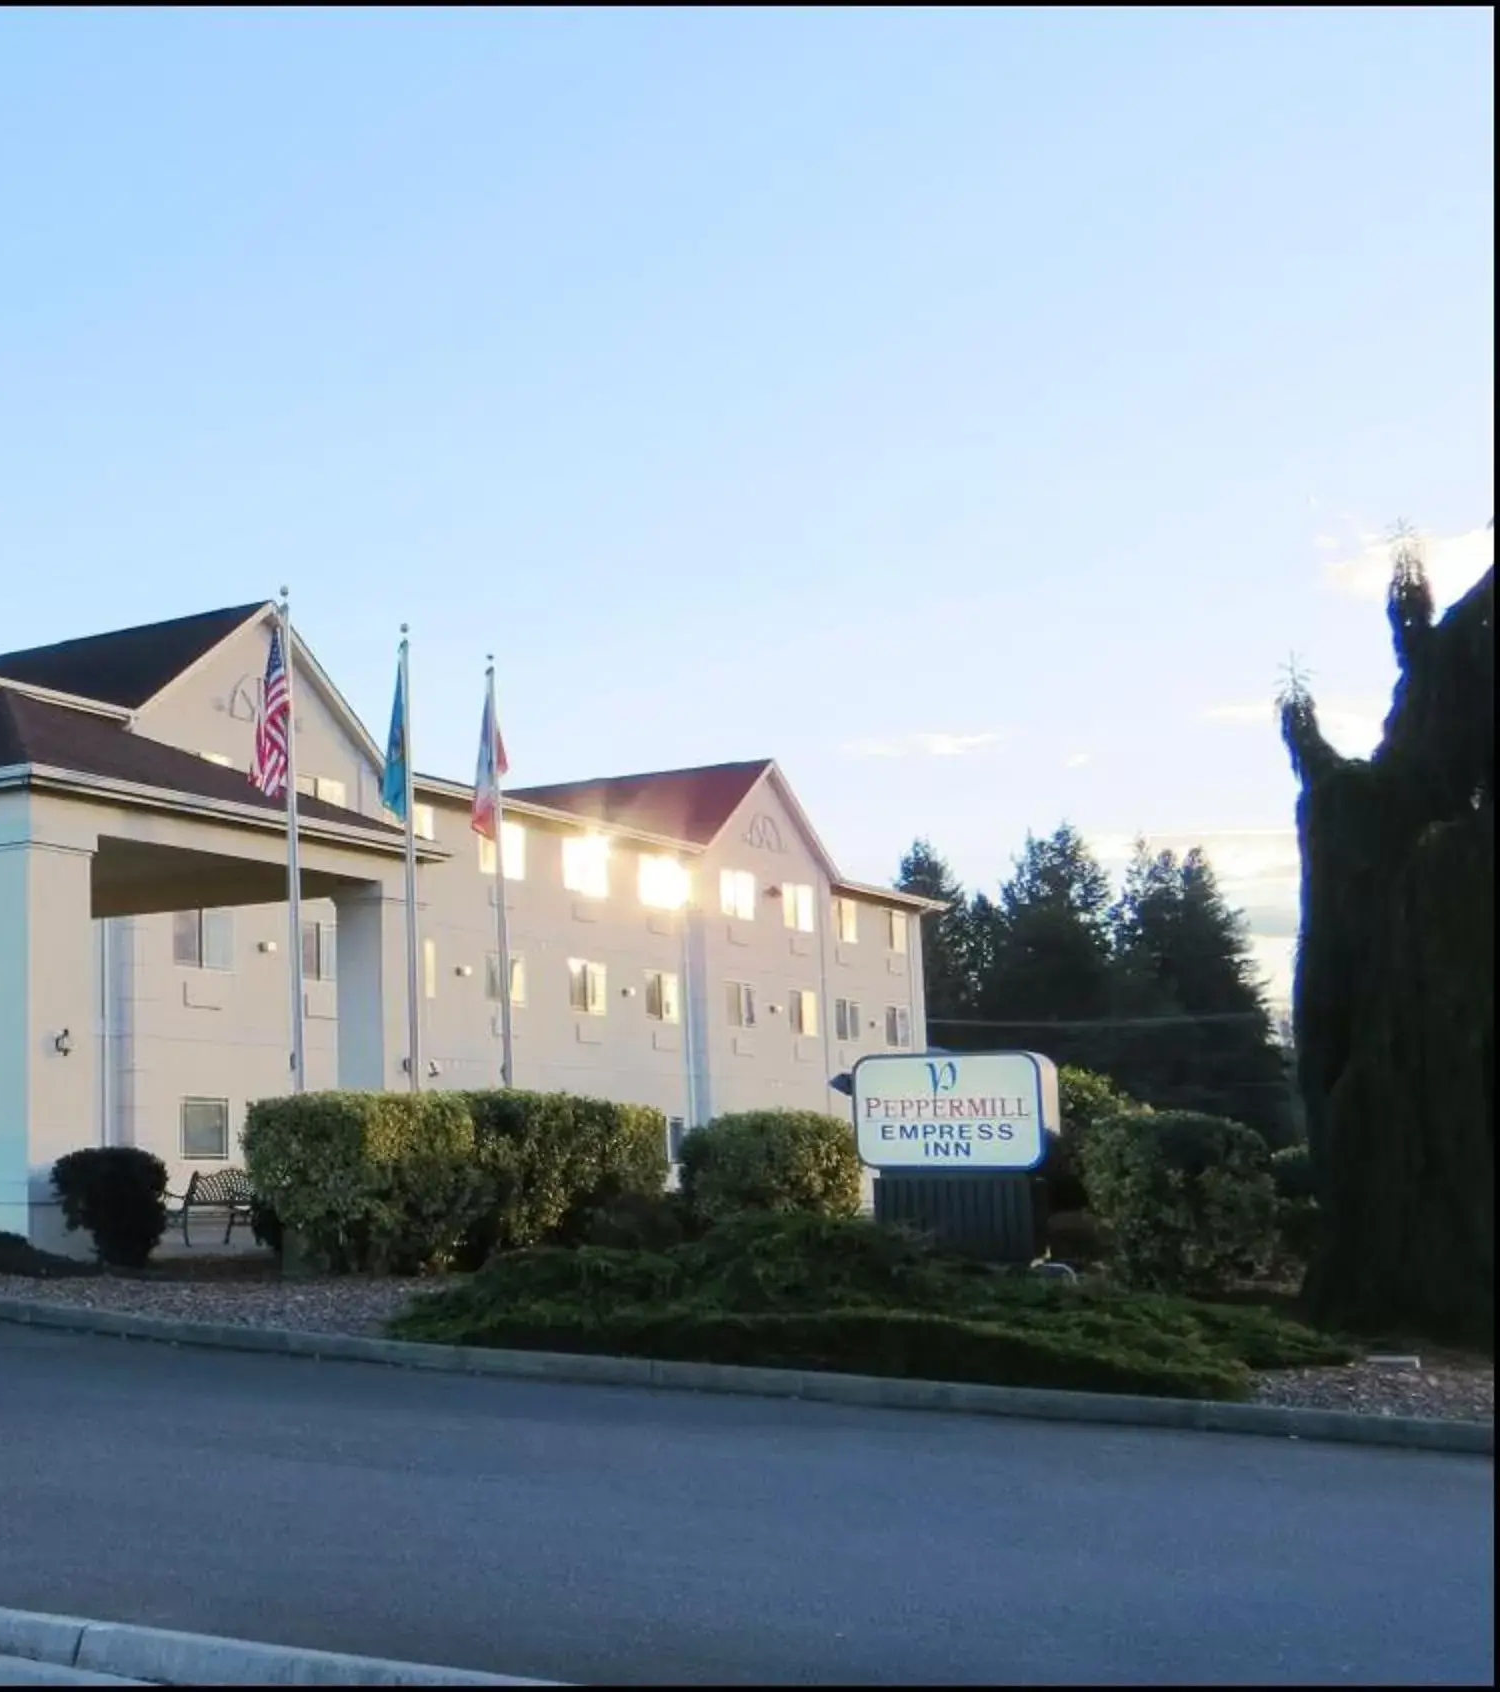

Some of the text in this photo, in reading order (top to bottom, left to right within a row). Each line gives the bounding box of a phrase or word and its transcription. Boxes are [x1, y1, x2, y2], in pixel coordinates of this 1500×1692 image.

[866, 1098, 1029, 1118] PEPPERMILL
[881, 1124, 1014, 1140] EMPRESS
[924, 1142, 971, 1157] INN
